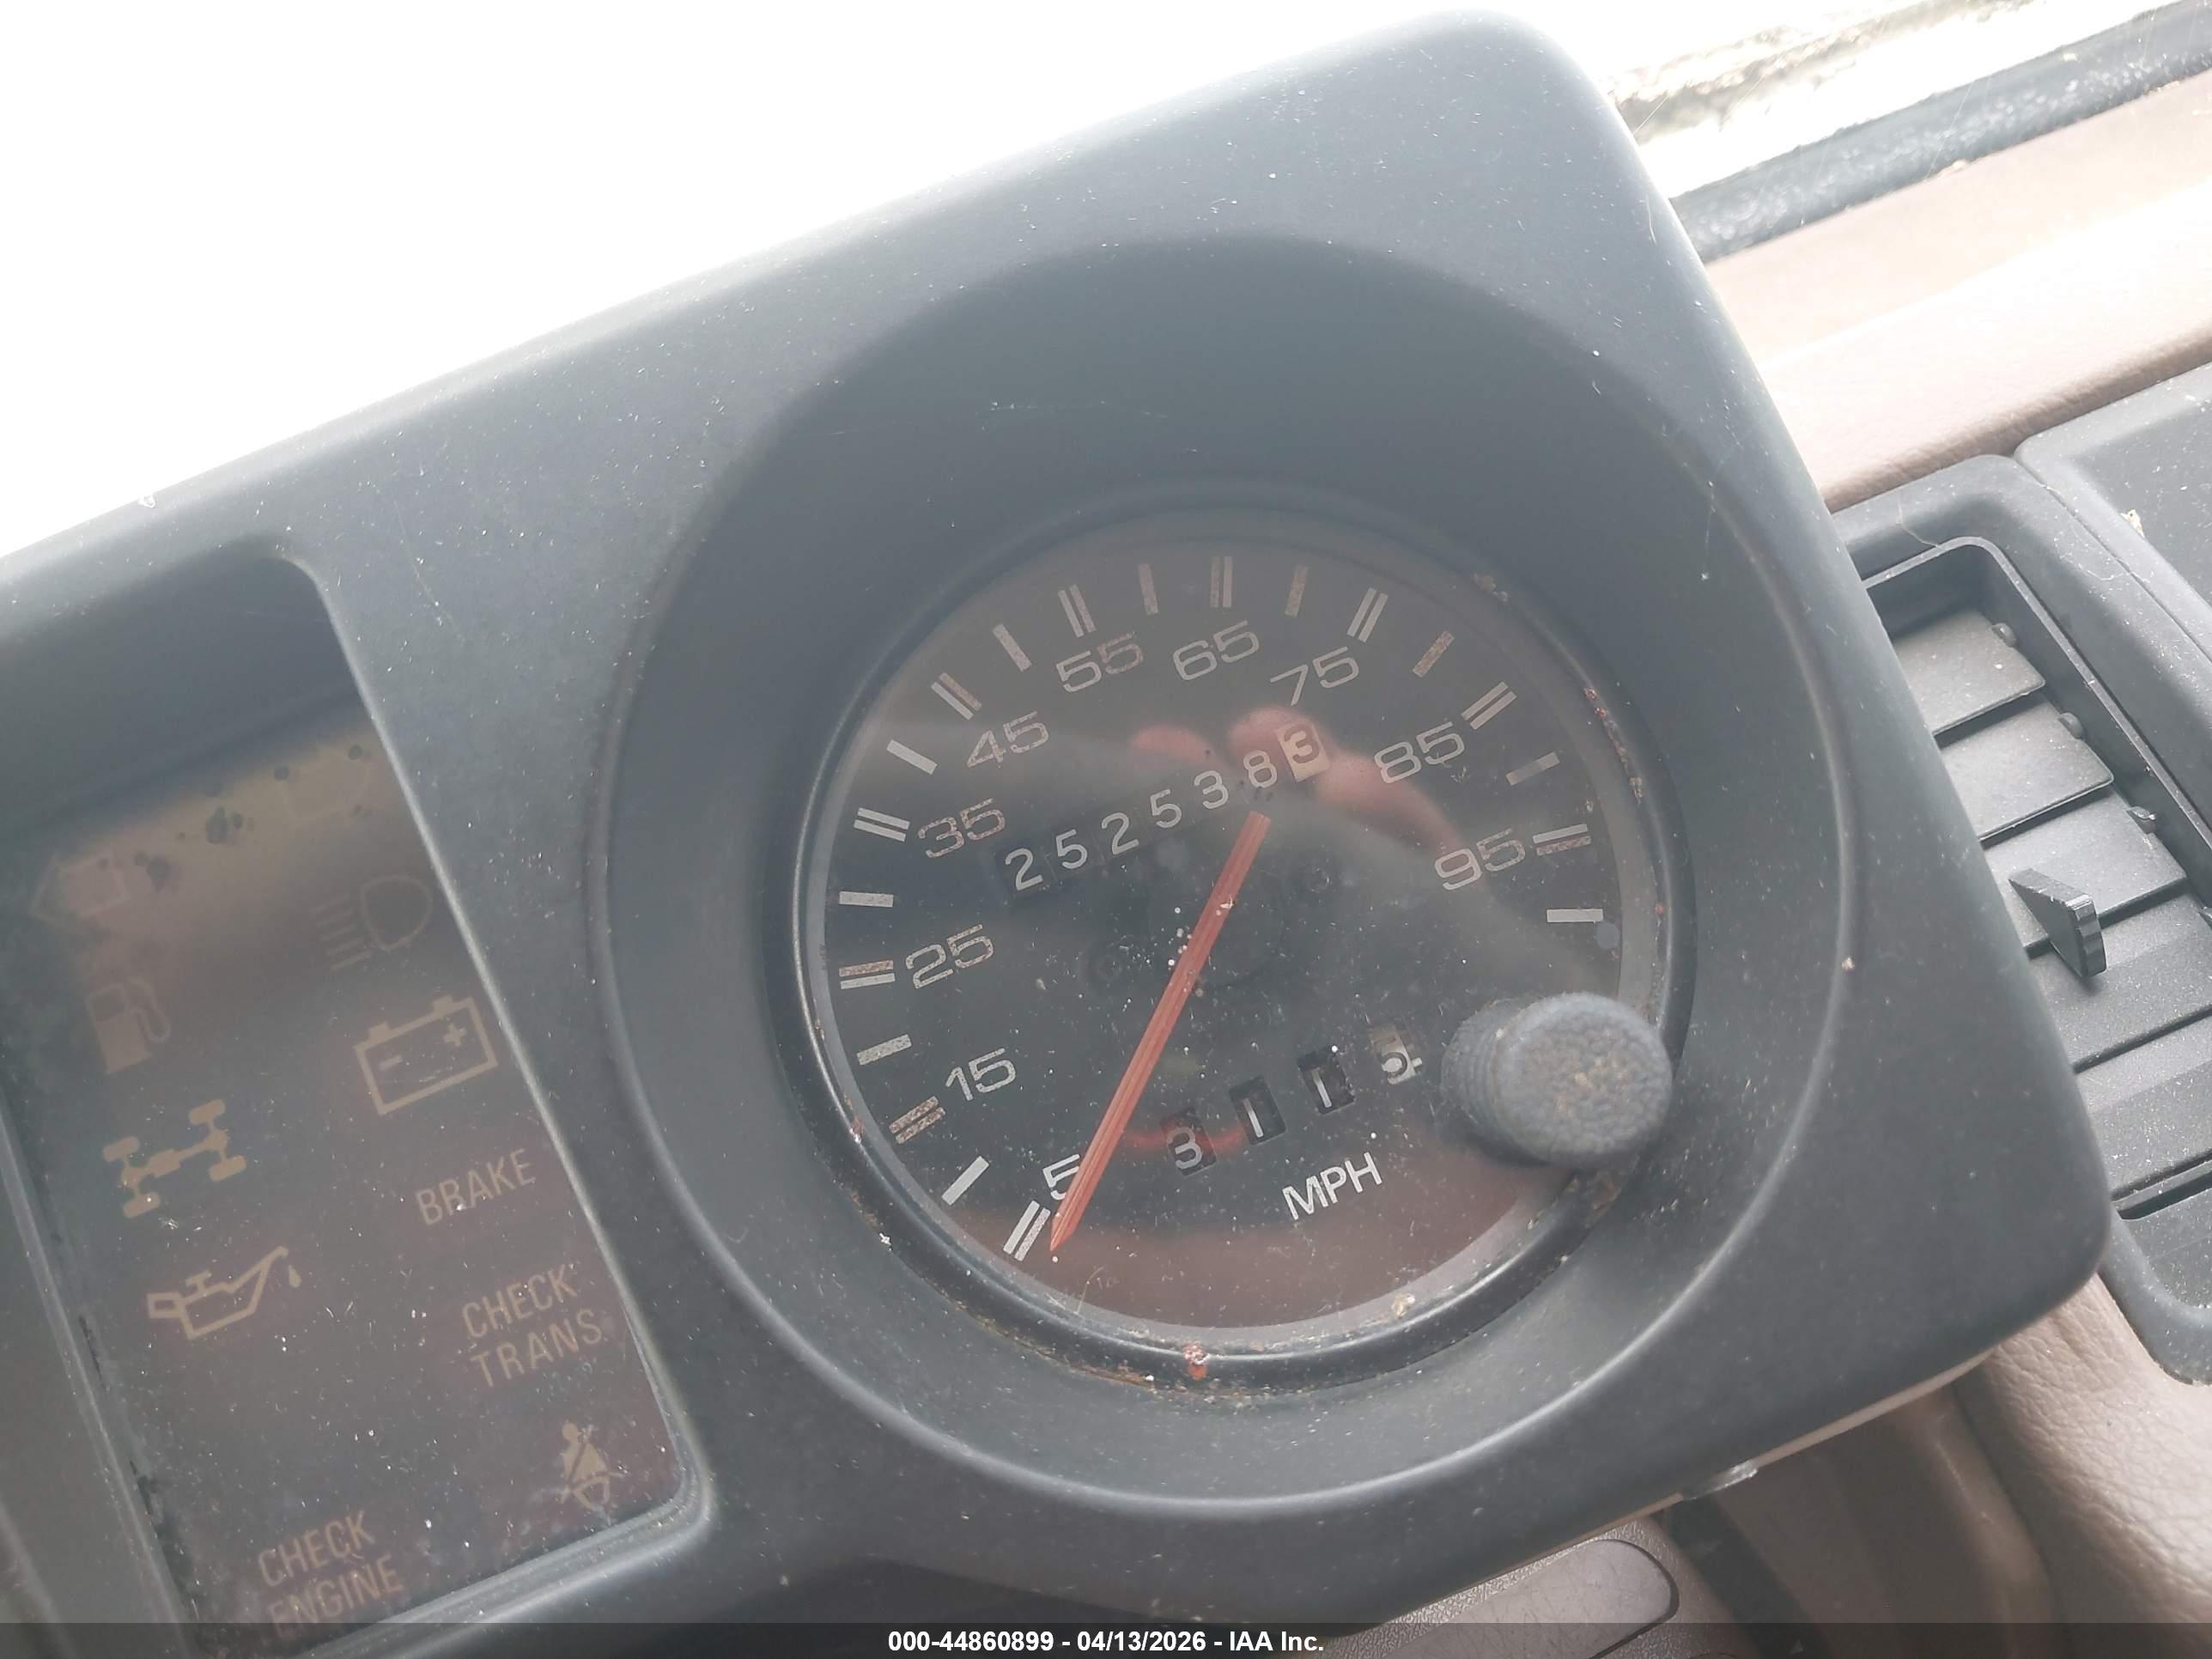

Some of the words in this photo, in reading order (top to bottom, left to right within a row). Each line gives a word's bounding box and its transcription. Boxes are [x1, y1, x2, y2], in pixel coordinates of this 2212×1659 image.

[1056, 631, 1144, 692] 55
[1173, 620, 1260, 681] 65
[1270, 646, 1359, 707] 75
[966, 711, 1049, 768] 45
[1374, 721, 1465, 784] 85
[917, 798, 1006, 859] 35
[1434, 828, 1526, 890] 95
[905, 923, 994, 988] 25
[945, 1048, 1017, 1101] 15
[415, 1148, 536, 1226] BRAKE
[1042, 1153, 1081, 1201] 5
[1282, 1152, 1382, 1219] MPH
[462, 1263, 579, 1339] CHECK
[470, 1309, 603, 1388] TRANS
[258, 1510, 376, 1589] CHECK
[265, 1554, 407, 1641] ENGINE
